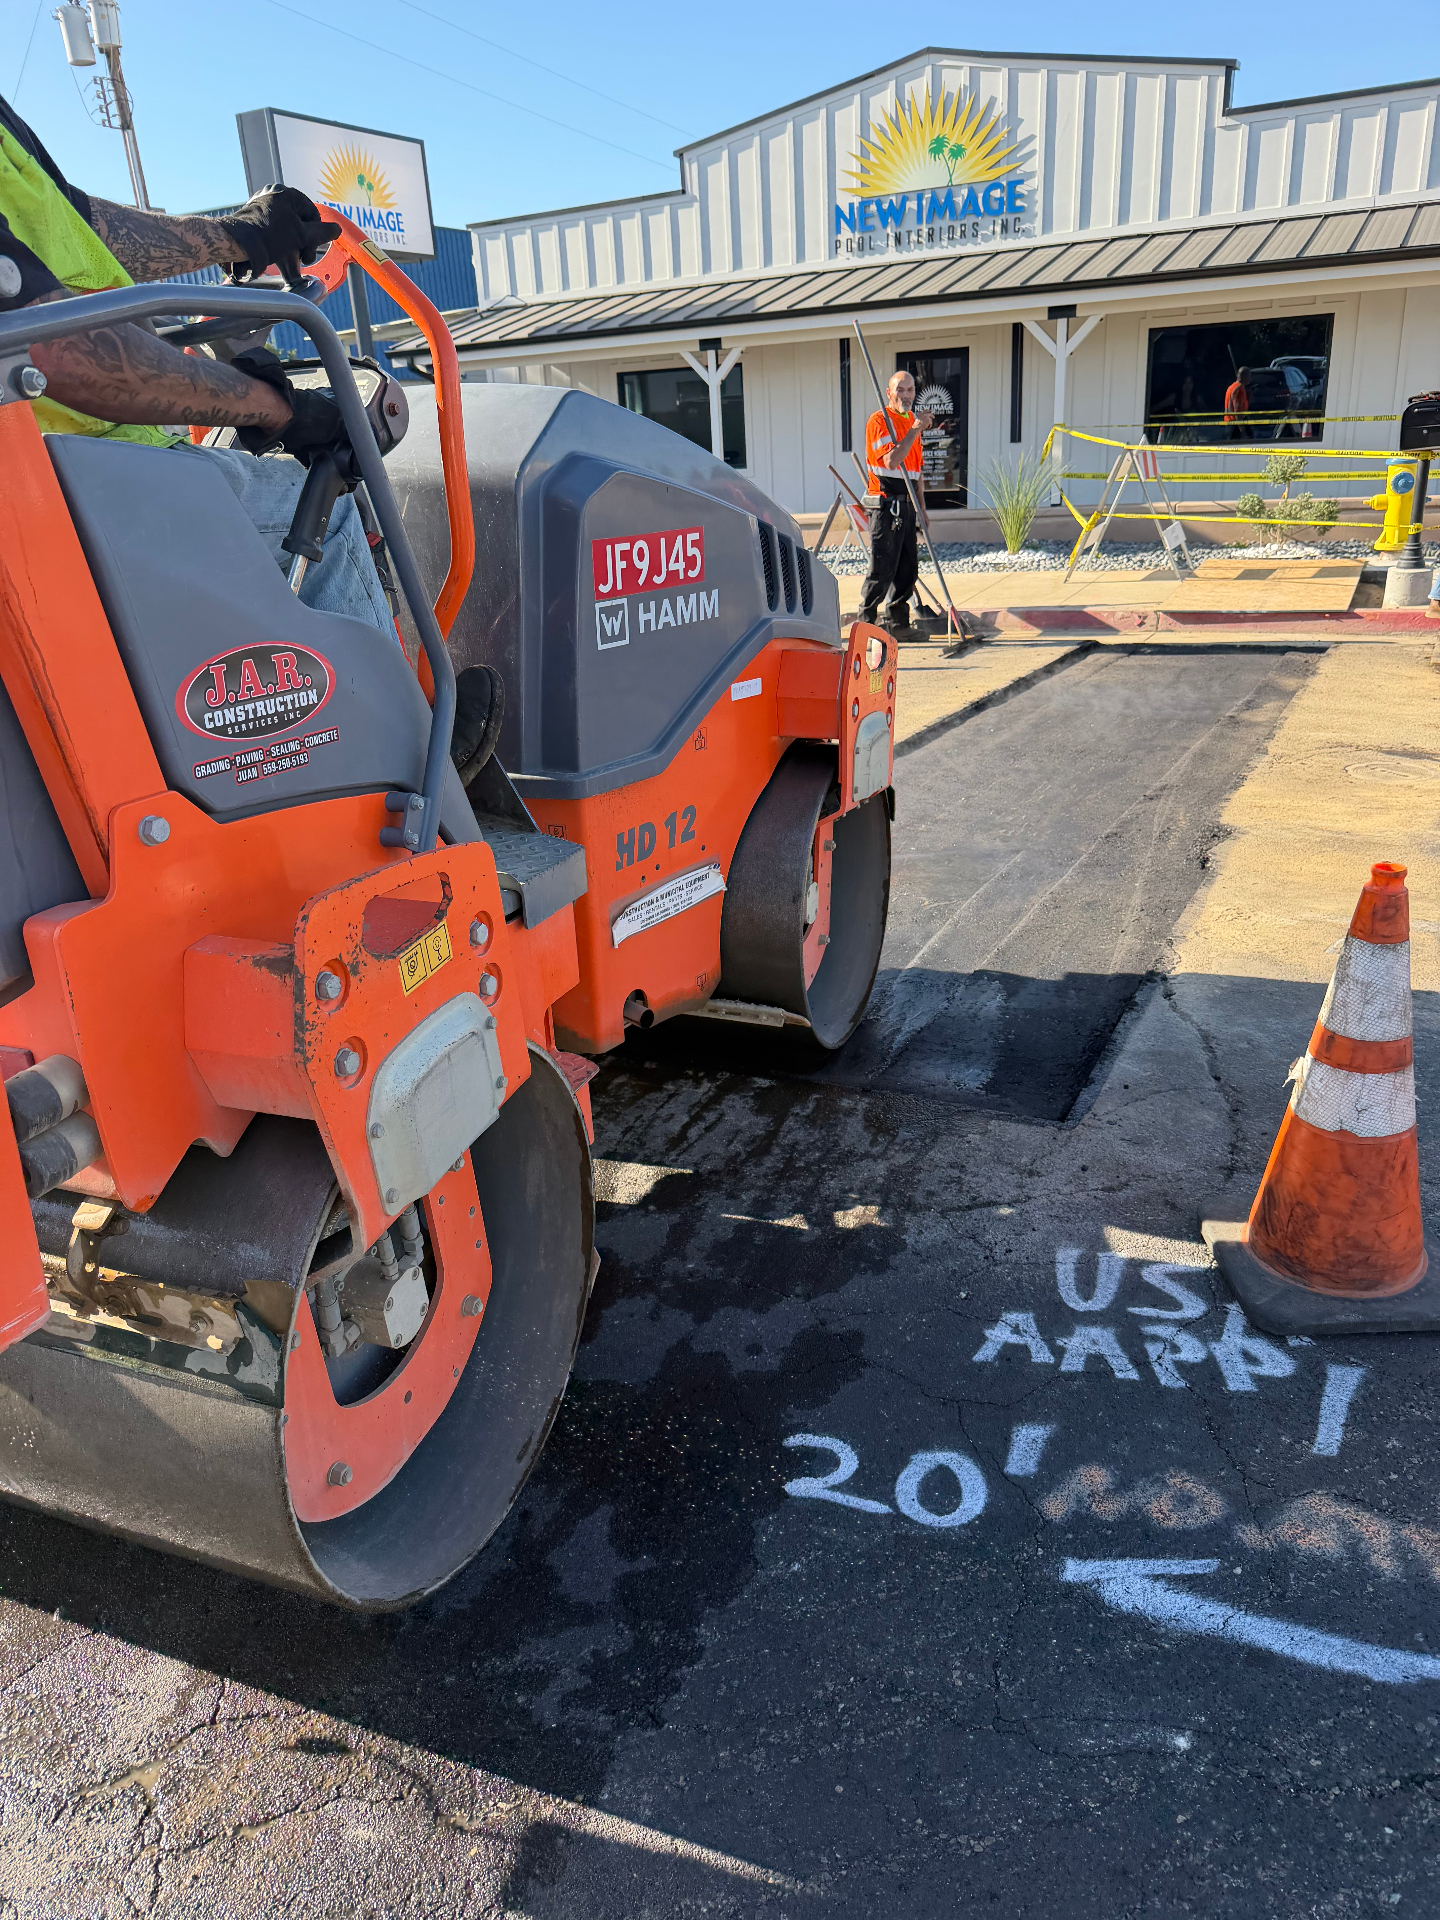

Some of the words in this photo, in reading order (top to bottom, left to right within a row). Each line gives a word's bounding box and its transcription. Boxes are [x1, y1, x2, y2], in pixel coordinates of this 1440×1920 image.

[356, 205, 405, 233] IMAGE
[835, 194, 908, 235] NEW
[916, 179, 1025, 225] IMAGE
[835, 236, 875, 255] POOL
[886, 222, 979, 248] INTERIORS
[992, 217, 1026, 236] INC.
[931, 403, 954, 411] IMAGE
[638, 588, 719, 634] HAMM
[205, 651, 312, 708] J.A.R.
[203, 688, 319, 730] CONSTRUCTION
[227, 716, 279, 735] SERVICES
[195, 758, 231, 779] GRADING
[235, 750, 264, 767] PAVING
[270, 740, 301, 758] SEALING
[304, 729, 339, 748] CONCRETE
[237, 767, 258, 783] JUAN
[262, 753, 309, 775] 559-250-5193
[615, 821, 656, 872] HD
[664, 804, 697, 850] 12
